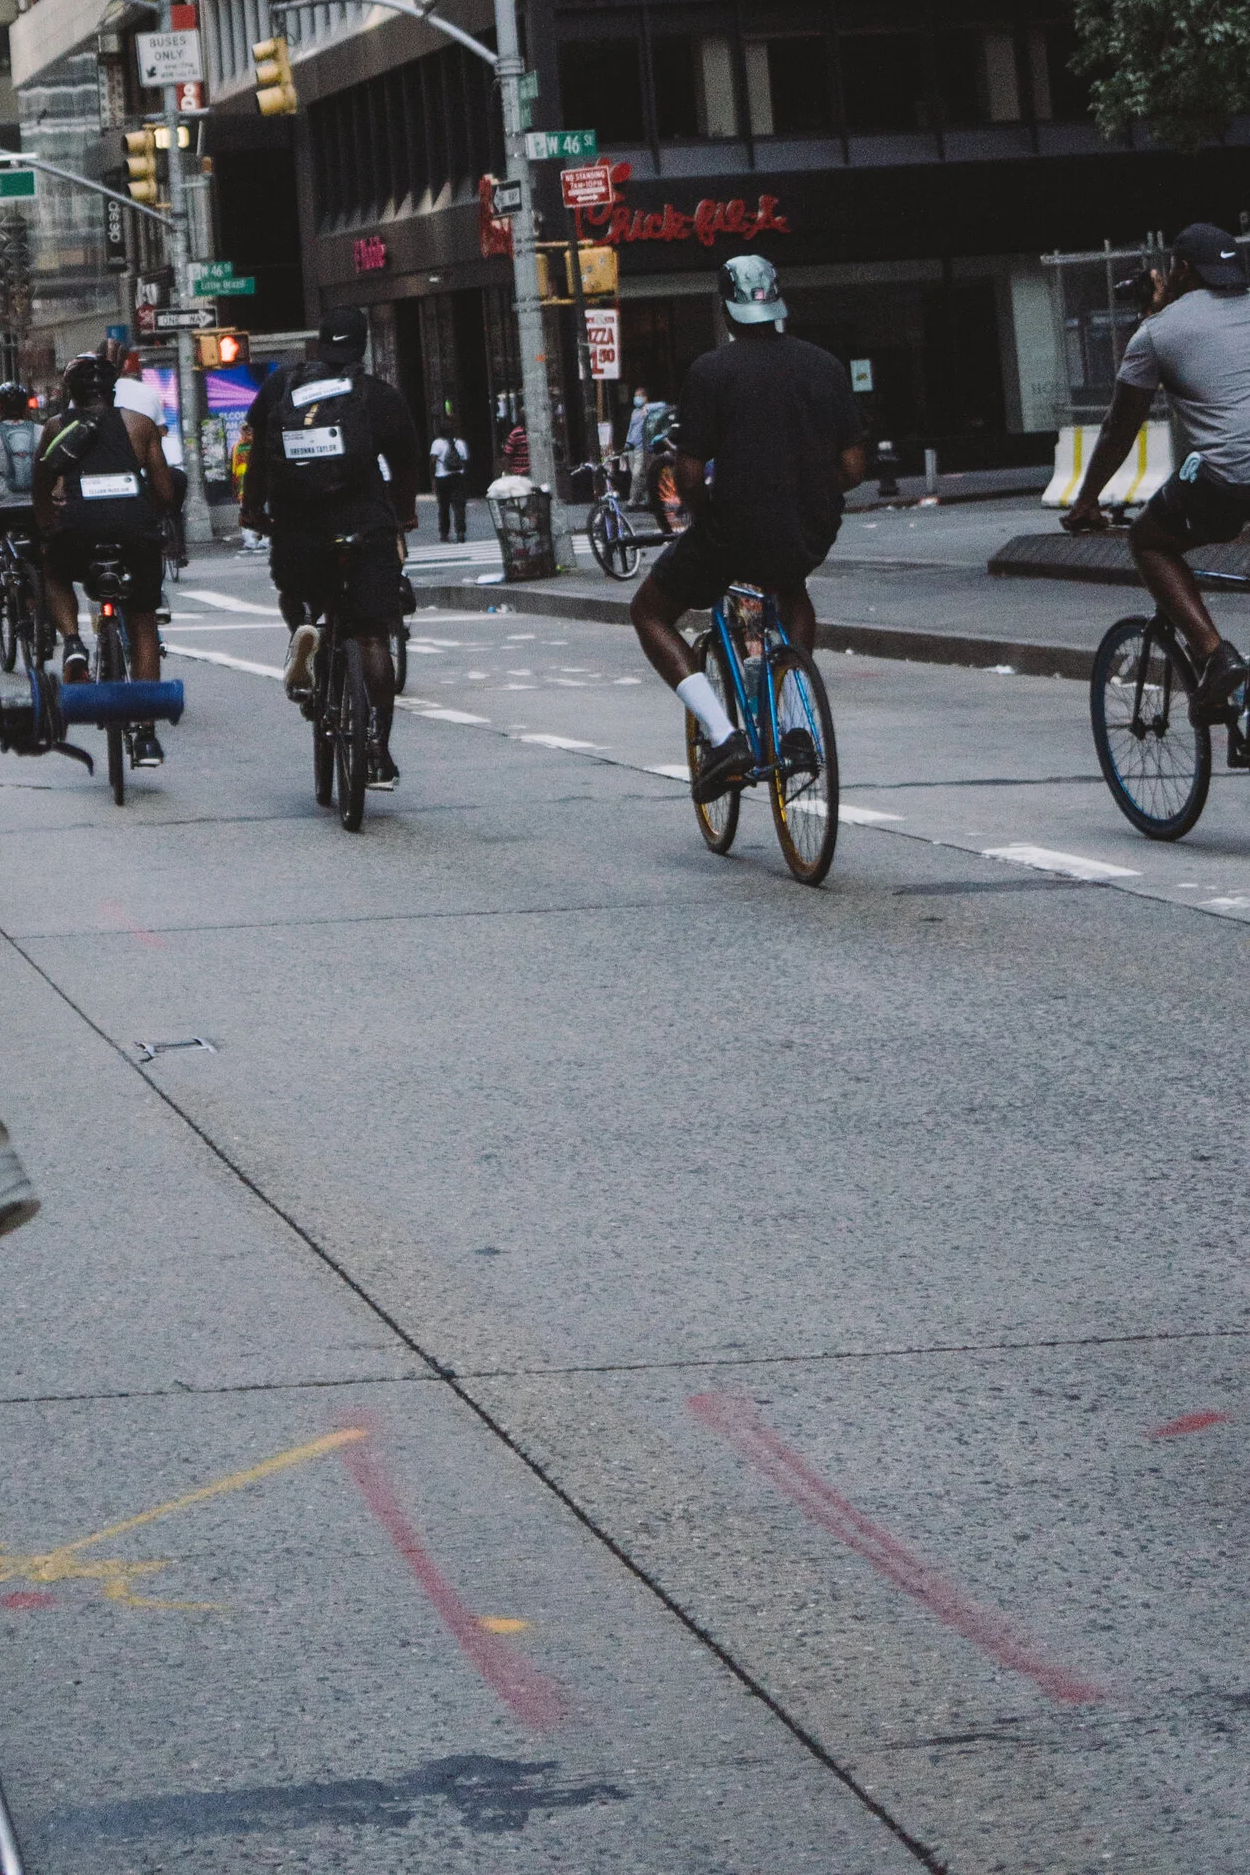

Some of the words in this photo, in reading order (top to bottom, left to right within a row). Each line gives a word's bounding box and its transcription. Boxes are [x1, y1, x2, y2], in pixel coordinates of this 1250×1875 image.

[149, 35, 187, 49] BUSES
[154, 49, 183, 62] ONLY
[546, 135, 558, 155] W
[562, 134, 581, 155] 46
[565, 172, 575, 182] NO
[575, 169, 606, 181] STANDING
[211, 264, 223, 277] 46
[587, 328, 614, 344] IZZA
